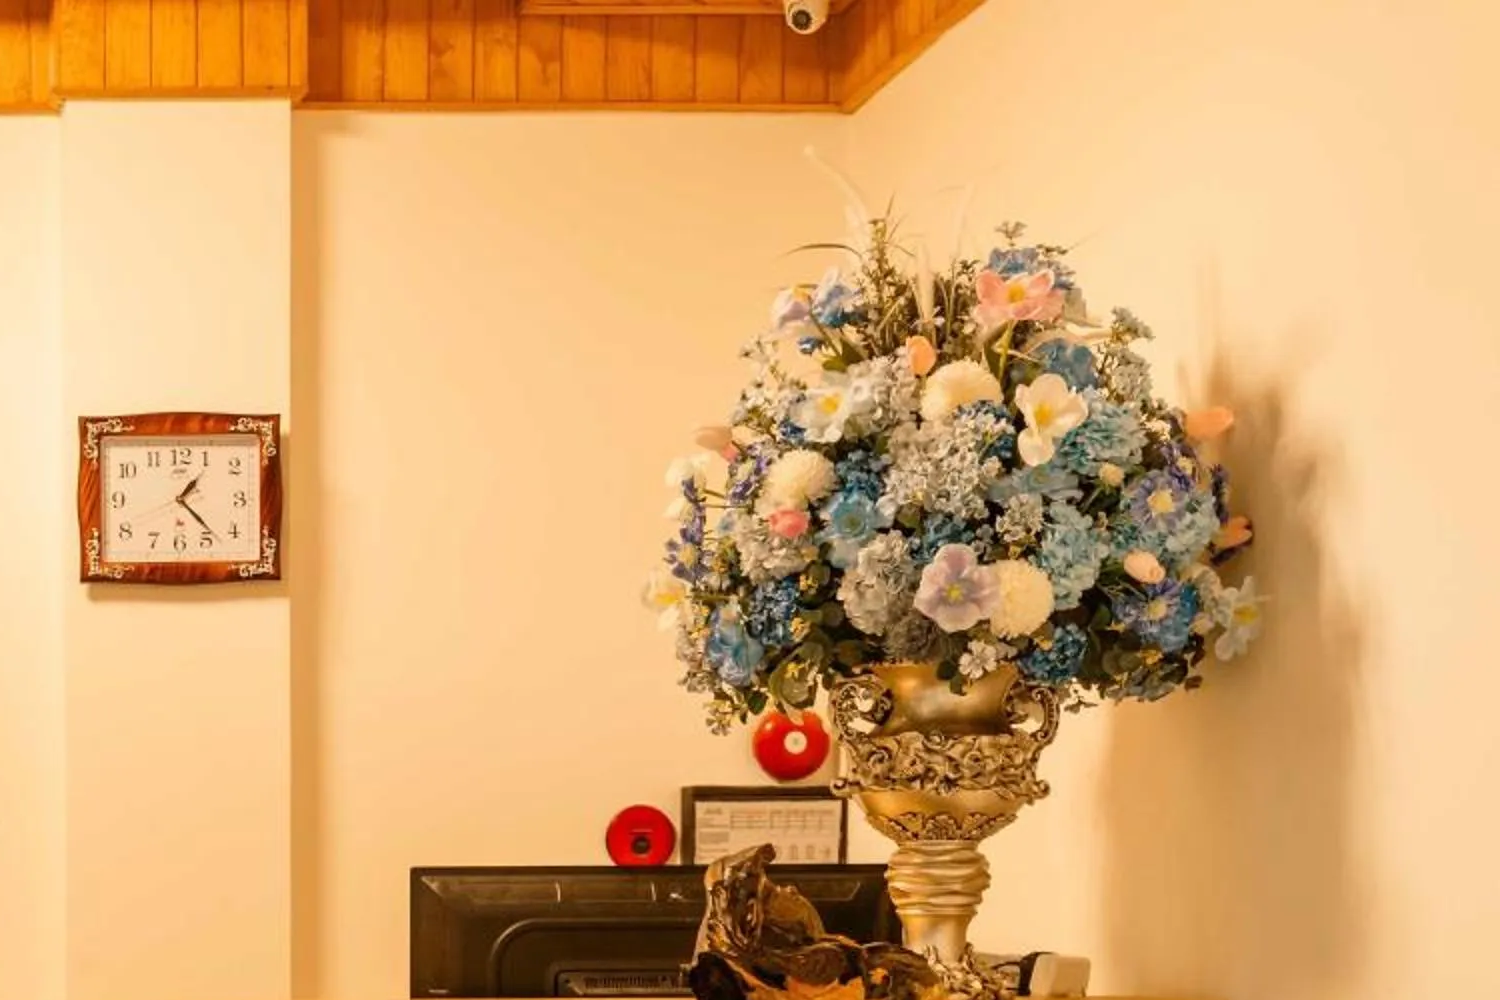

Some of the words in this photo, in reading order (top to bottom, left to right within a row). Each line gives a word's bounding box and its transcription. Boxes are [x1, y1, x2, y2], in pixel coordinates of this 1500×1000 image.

[146, 451, 161, 468] 11
[169, 447, 192, 466] 12
[201, 451, 211, 468] 1
[119, 463, 137, 479] 10
[228, 458, 242, 476] 2
[112, 492, 126, 510] 9
[233, 492, 247, 508] 3
[118, 522, 133, 539] 8
[228, 522, 241, 539] 4
[148, 532, 161, 549] 7
[173, 534, 187, 552] 6
[199, 531, 213, 548] 5
